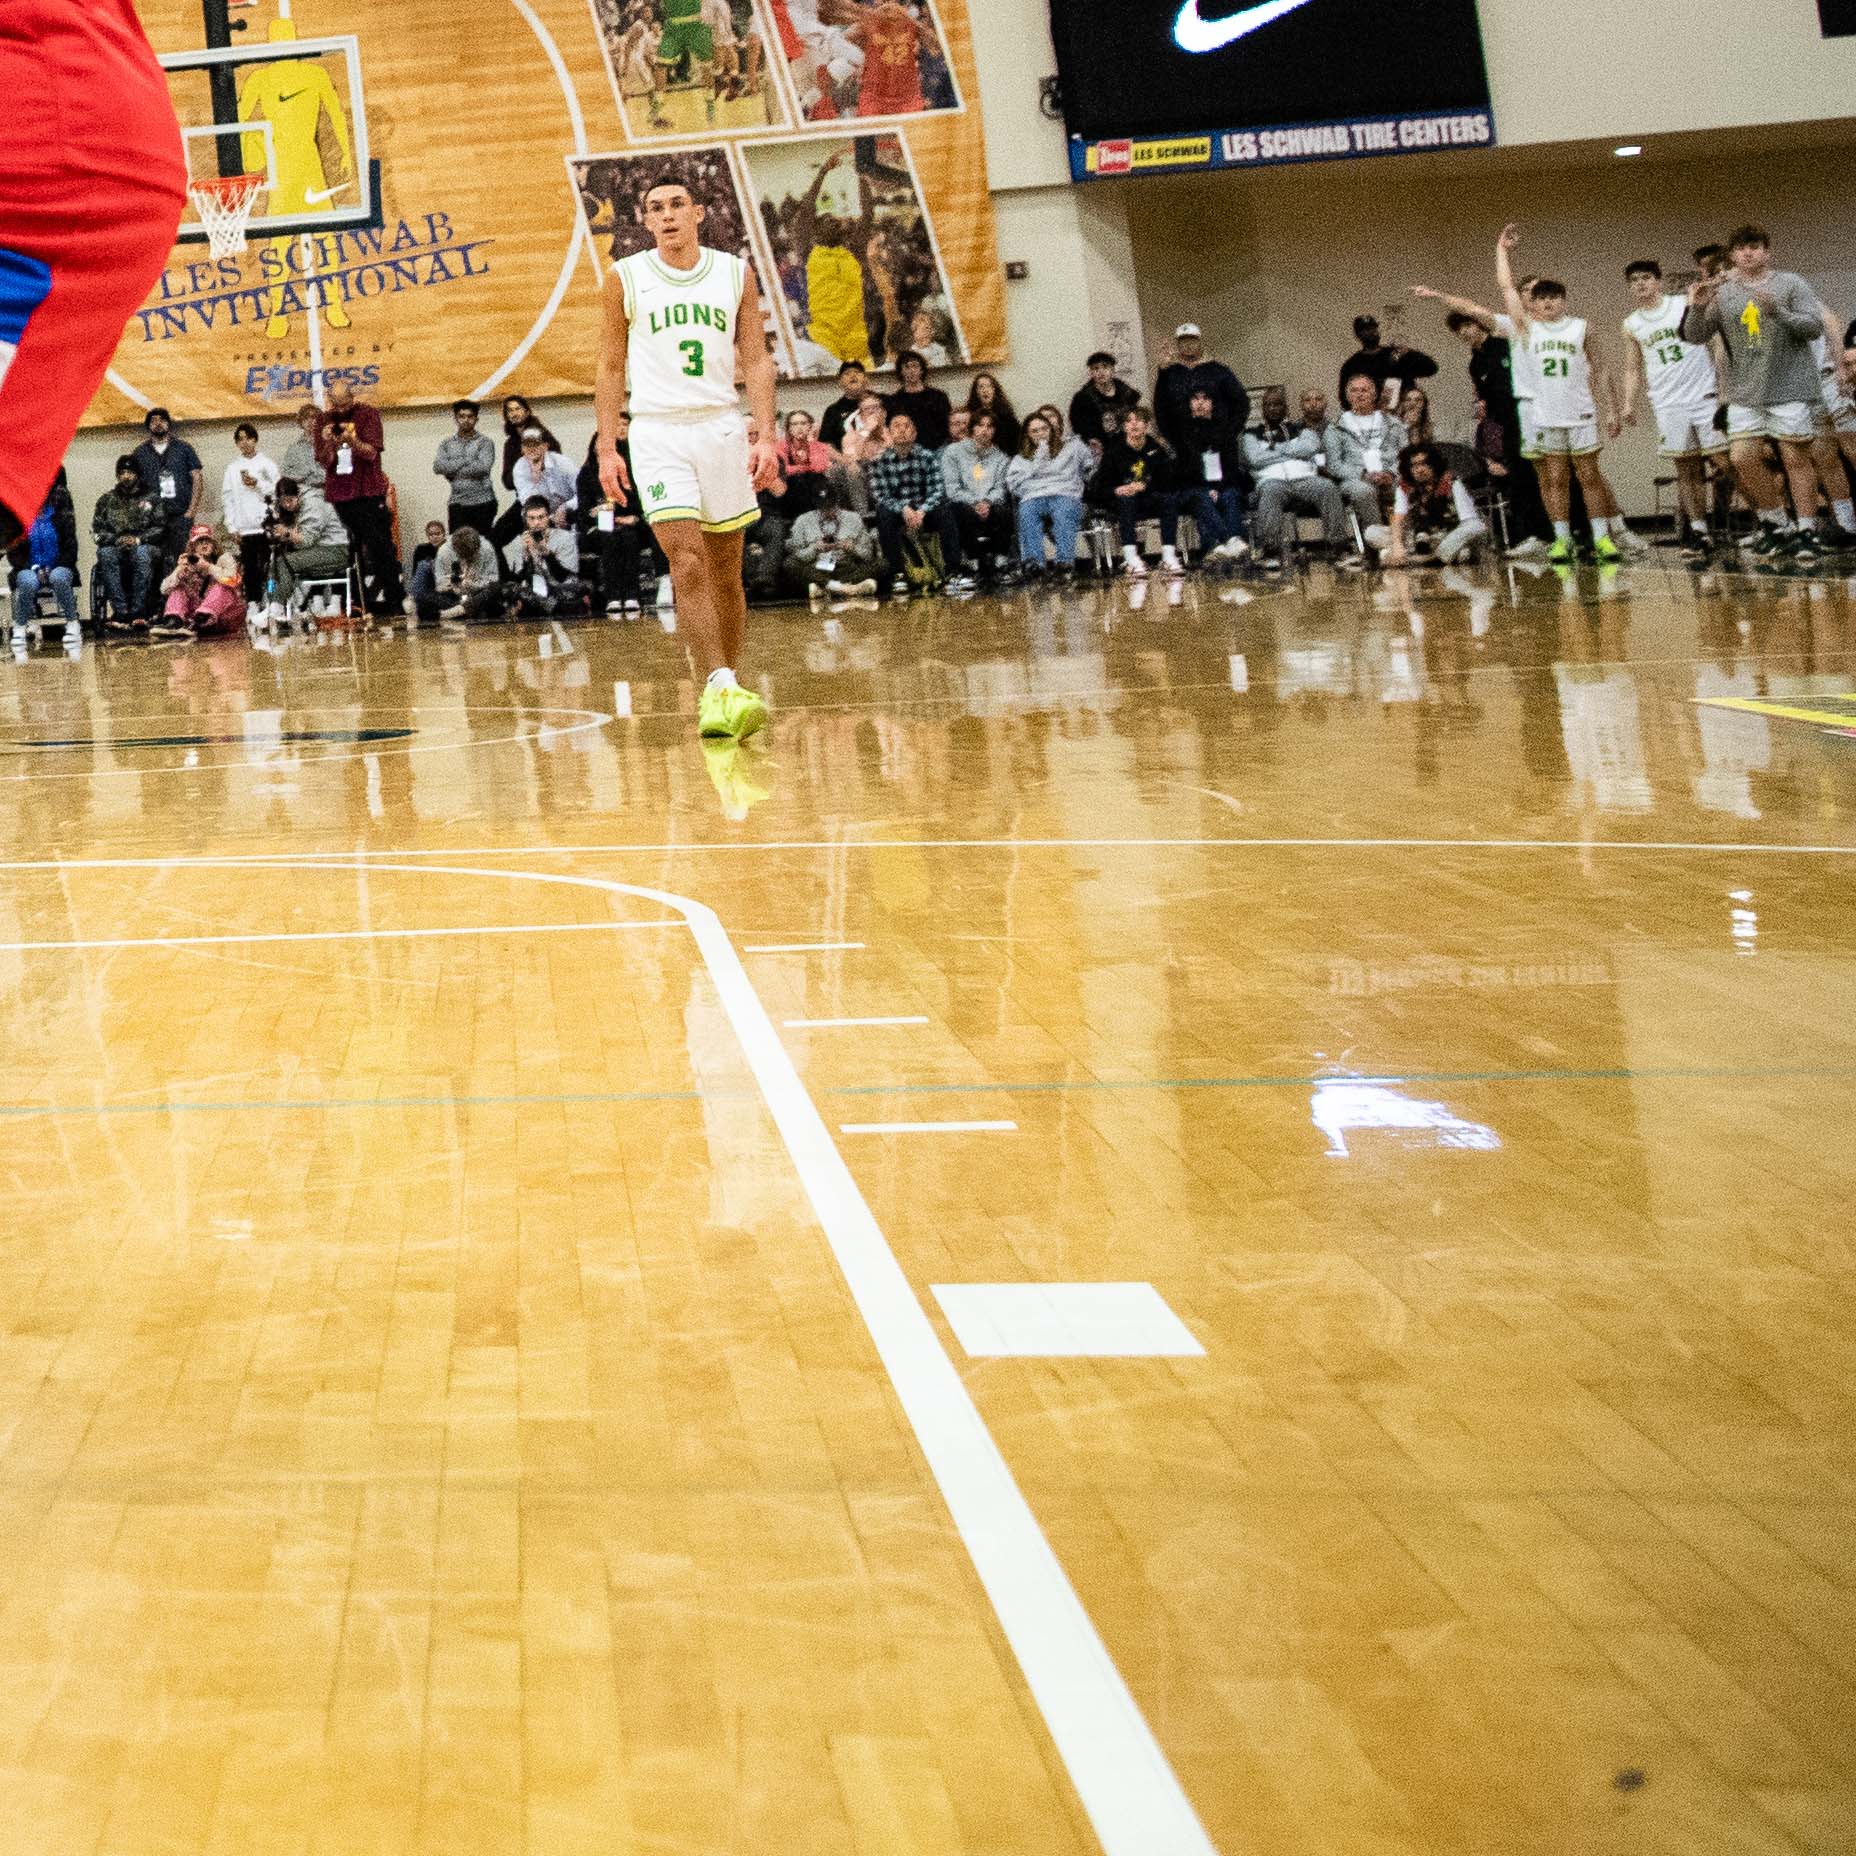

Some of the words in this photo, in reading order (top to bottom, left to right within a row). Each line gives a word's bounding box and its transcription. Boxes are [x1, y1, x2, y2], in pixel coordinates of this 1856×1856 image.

[1221, 133, 1257, 162] LES
[1259, 126, 1349, 160] SCHWAB
[1350, 121, 1397, 152] TIRE
[1398, 113, 1489, 148] CENTERS
[160, 257, 243, 301] LES
[258, 211, 455, 278] SCHWAB
[137, 244, 489, 343] INVITATIONAL
[648, 303, 728, 335] LIONS
[678, 339, 704, 377] 3
[1542, 357, 1569, 378] 21
